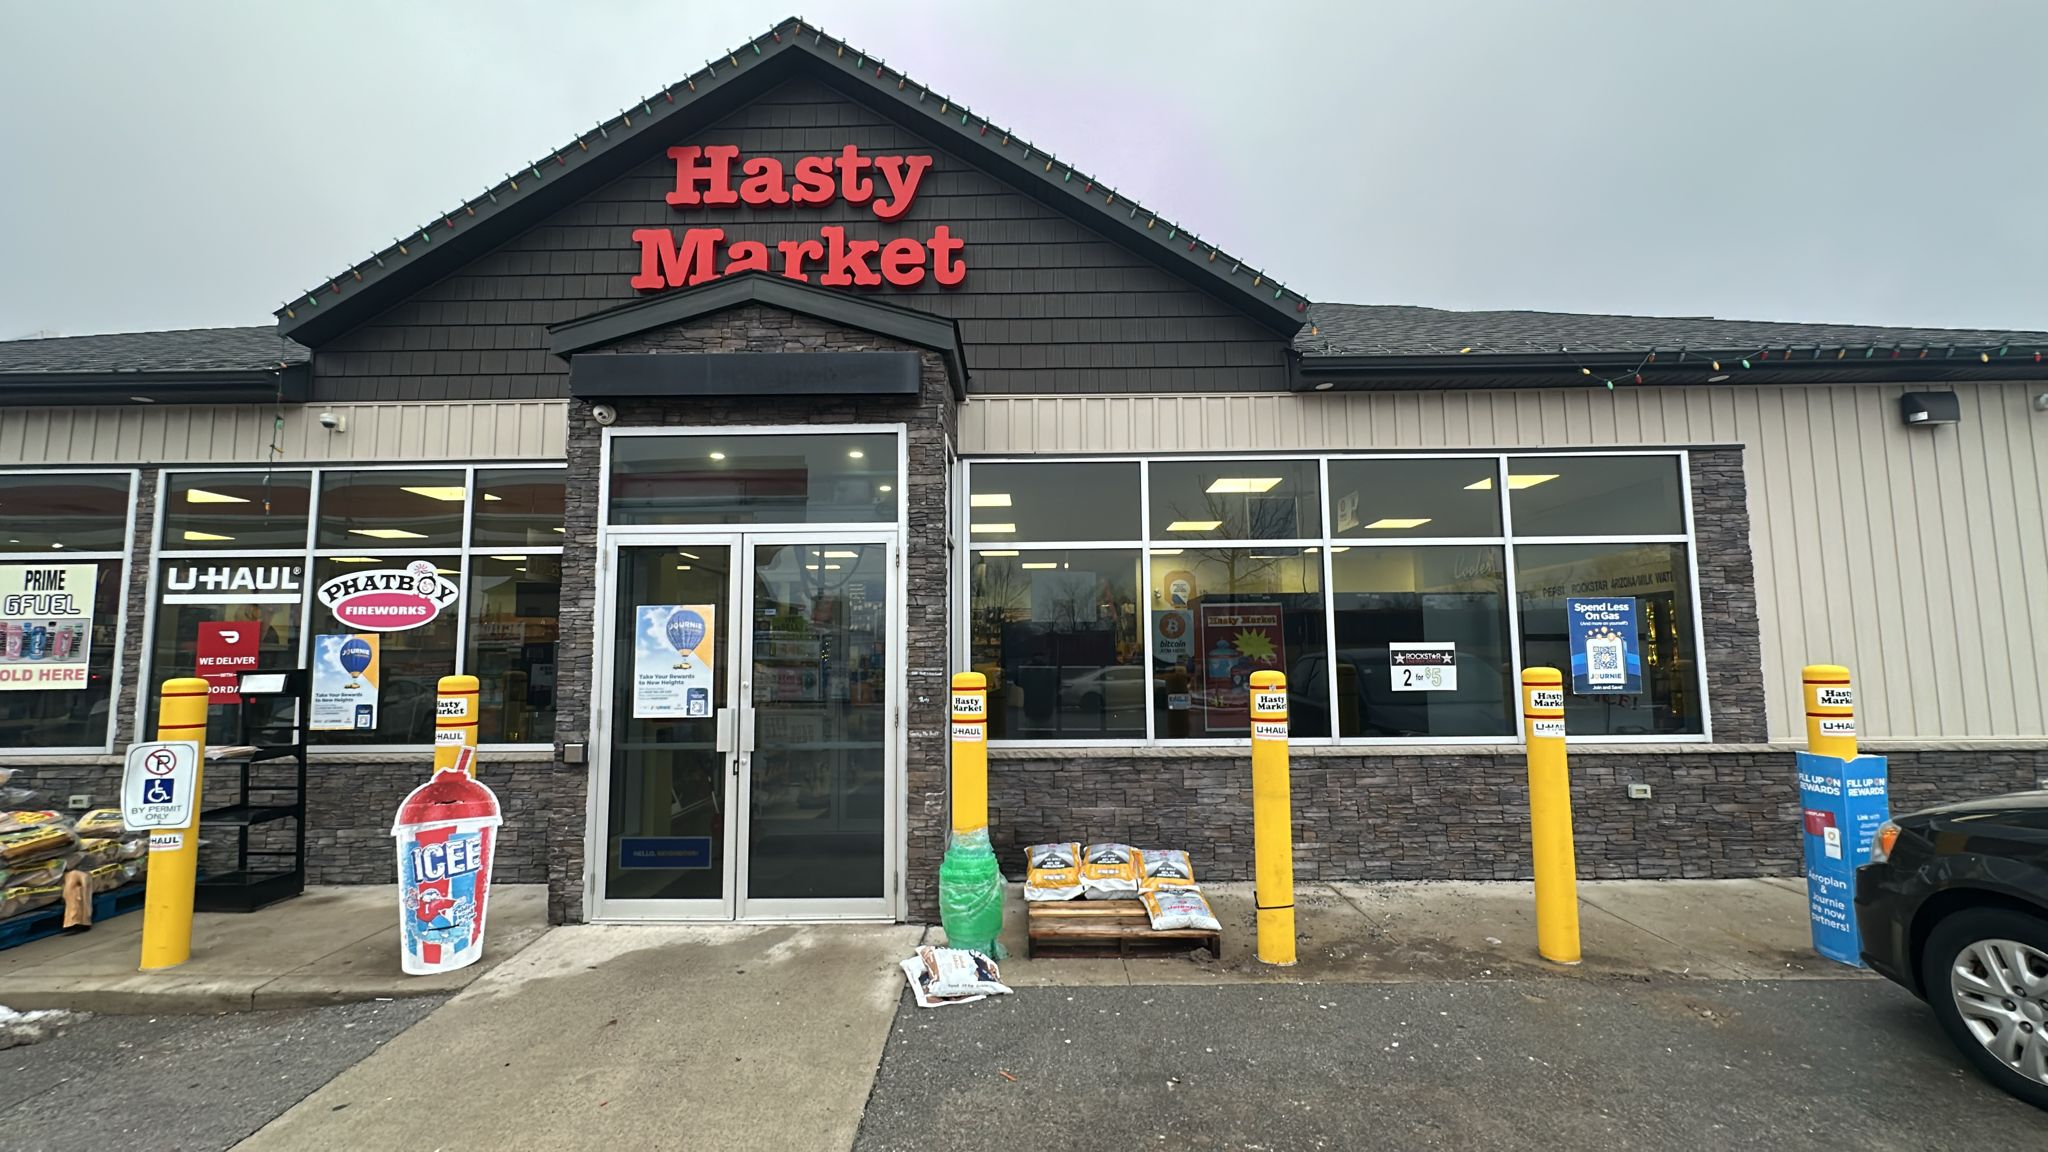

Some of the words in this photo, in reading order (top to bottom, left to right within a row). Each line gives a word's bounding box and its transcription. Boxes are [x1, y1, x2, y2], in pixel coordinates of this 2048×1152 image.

[665, 144, 932, 222] Hasty
[630, 225, 966, 288] Market
[24, 570, 66, 591] PRIME
[168, 566, 299, 590] U-HAUL
[1572, 580, 1608, 594] ROCKSTAR
[345, 605, 427, 616] FIREWORKS
[1574, 603, 1606, 612] Spend
[1607, 603, 1629, 611] Less
[1585, 612, 1599, 620] On
[1601, 611, 1620, 620] Gas
[669, 621, 702, 629] JOURNIE
[200, 657, 214, 665] WE
[216, 656, 255, 665] DELIVER
[0, 669, 33, 682] OLD
[39, 668, 85, 681] HERE
[1403, 668, 1412, 687] 2
[955, 697, 979, 705] Hasty
[953, 704, 982, 712] Market
[1812, 775, 1824, 784] UP
[1826, 777, 1841, 787] ON
[1847, 780, 1862, 788] FILL
[1874, 778, 1885, 786] ON
[1800, 781, 1840, 796] REWARDS
[1848, 787, 1885, 797] REWARDS
[132, 807, 146, 815] BY
[148, 805, 182, 813] PERMIT
[411, 839, 482, 884] ICEE
[1820, 885, 1827, 894] &
[1824, 908, 1845, 921] now
